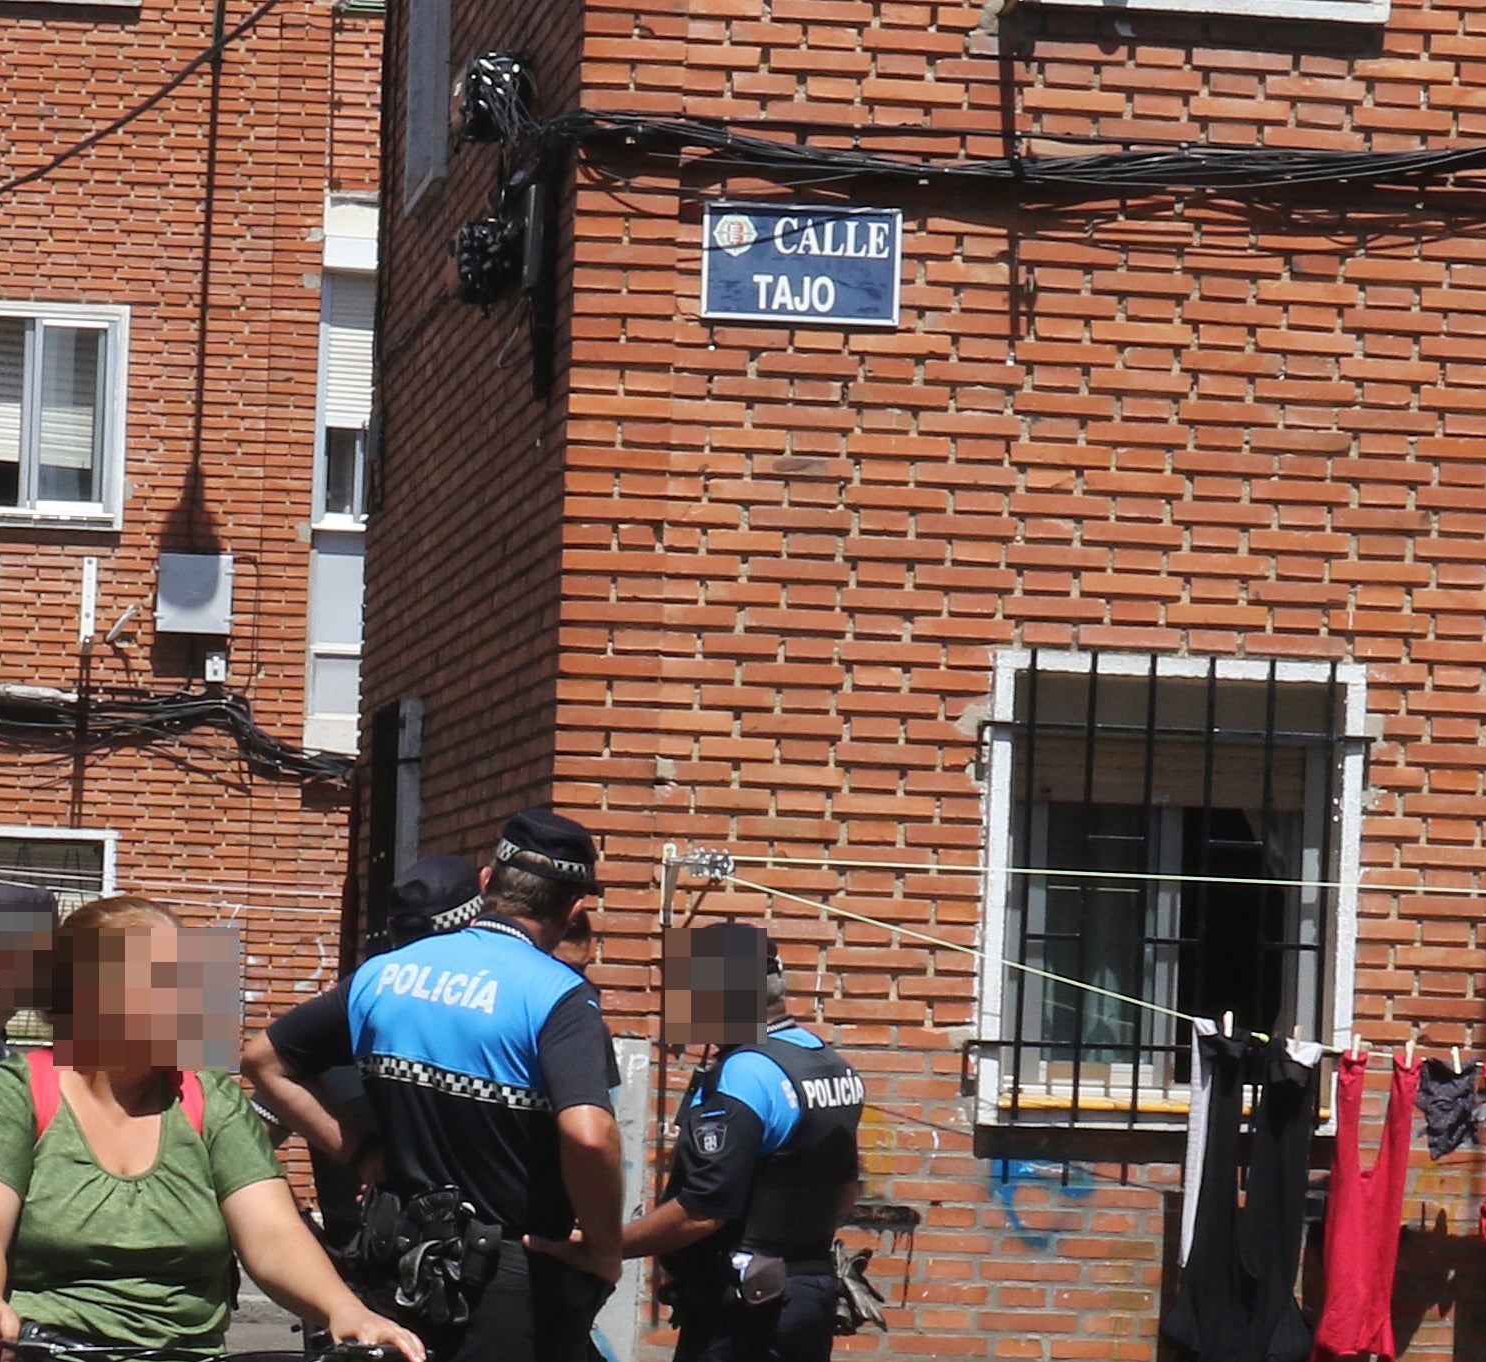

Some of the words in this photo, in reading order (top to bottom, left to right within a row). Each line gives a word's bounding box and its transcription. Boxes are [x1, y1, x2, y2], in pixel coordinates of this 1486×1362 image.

[773, 216, 891, 259] CALLE
[752, 274, 837, 313] TAJO
[376, 963, 499, 1014] POLICÍA
[801, 1068, 865, 1109] POLICÍA
